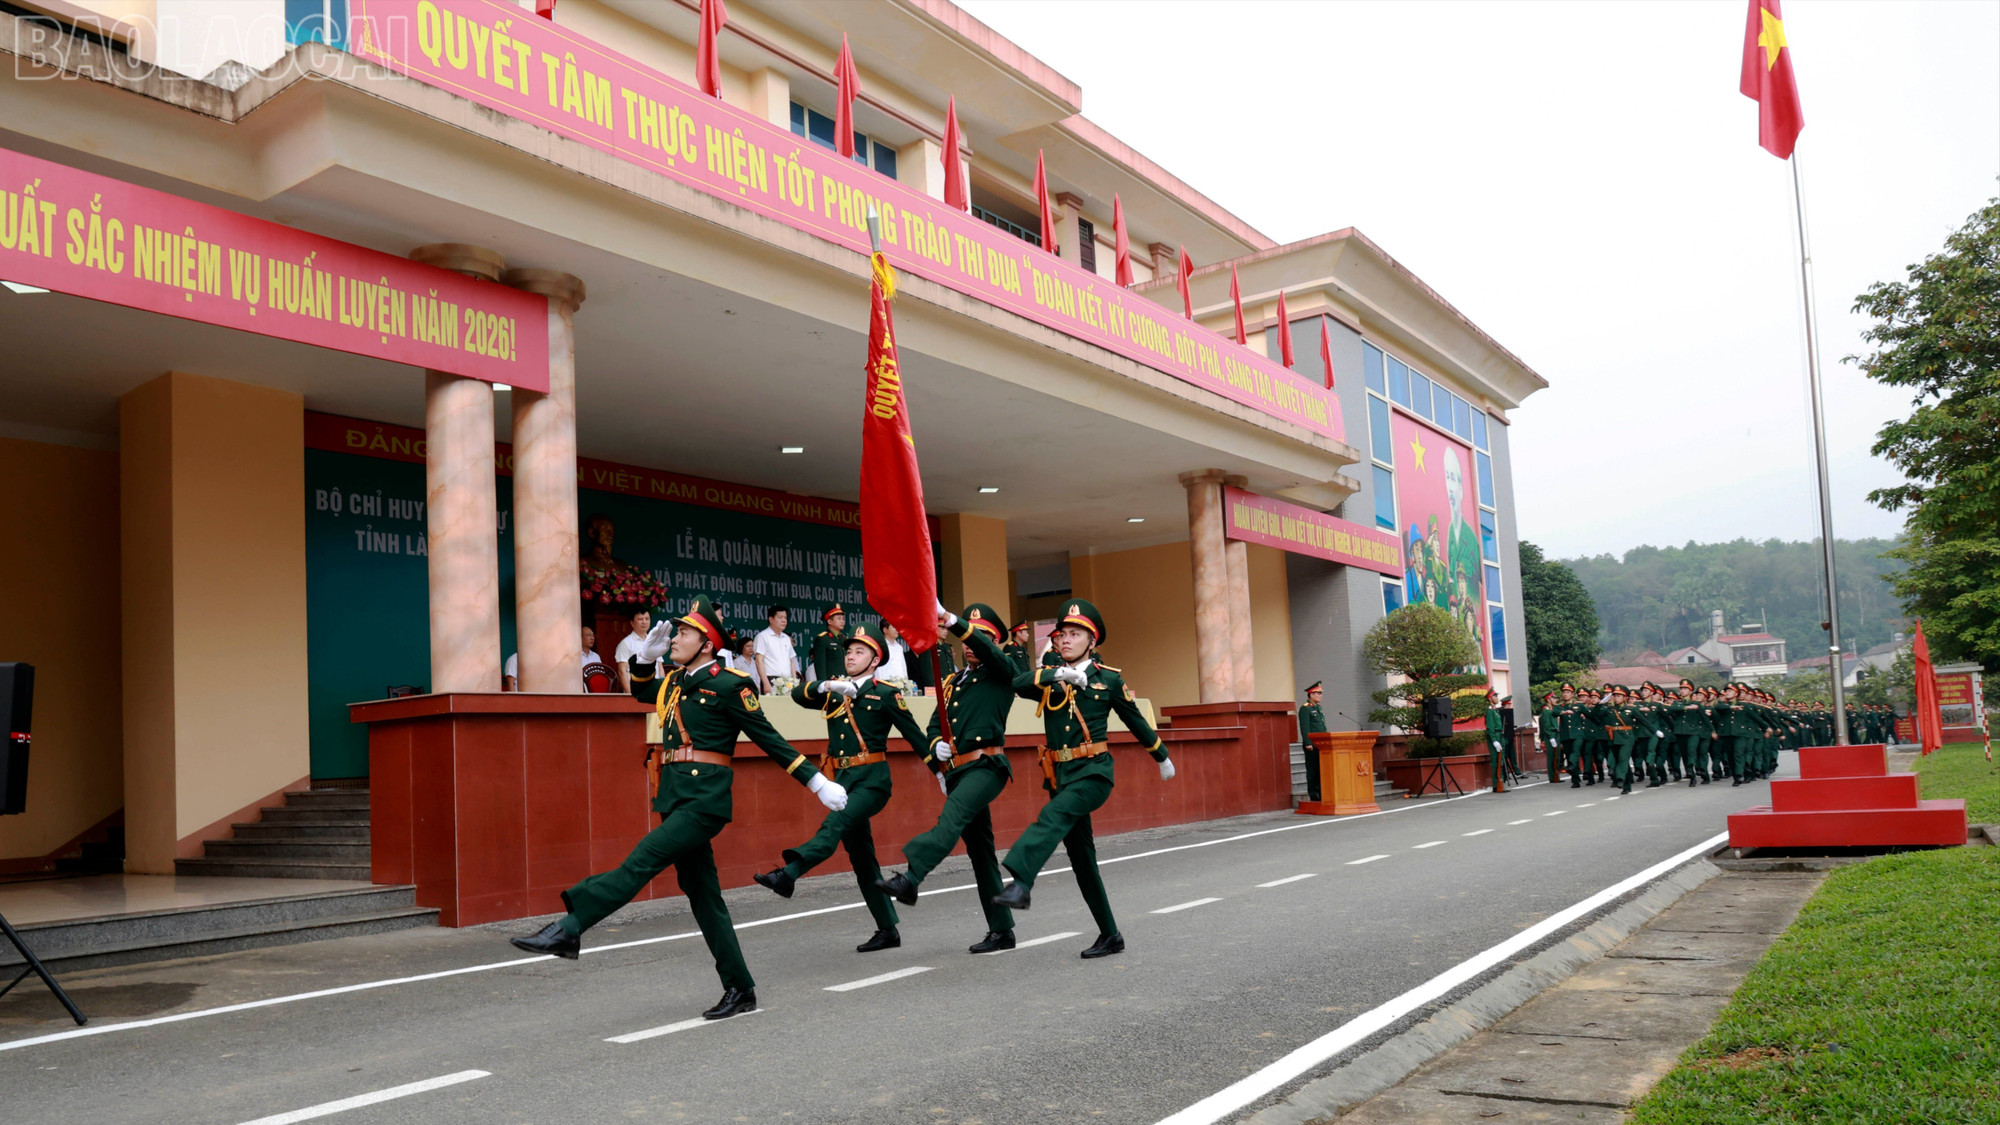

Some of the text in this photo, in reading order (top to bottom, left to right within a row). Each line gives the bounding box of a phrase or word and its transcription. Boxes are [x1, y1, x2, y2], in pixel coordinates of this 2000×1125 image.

[417, 0, 531, 96] QUYẾT
[541, 52, 613, 131] TÂM
[621, 86, 698, 167] THỰC
[705, 123, 769, 195] HIỆN
[773, 148, 815, 213] TỐT
[901, 208, 952, 268] TRÀO
[955, 231, 985, 282] THI
[987, 246, 1022, 297] ĐUA
[0, 177, 516, 362] UẤT SẮC NHIỆM VỤ HUẤN LUYỆN NĂM 2026!
[872, 355, 901, 420] QUYẾT
[345, 426, 427, 458] ĐẢNG
[592, 469, 644, 492] VIỆT
[651, 479, 698, 500] NAM
[705, 487, 775, 512] QUANG
[781, 500, 822, 519] VINH
[827, 504, 862, 526] MUÔ
[315, 486, 343, 517] BỘ
[350, 489, 382, 517] CHỈ
[388, 497, 425, 522] HUY
[355, 524, 429, 557] TỈNH LÀ
[676, 527, 864, 580] LỄ RA QUÂN HUẤN LUYỆN NĂ
[655, 569, 672, 588] VÀ
[675, 570, 707, 591] PHÁT
[710, 574, 744, 596] ĐỘNG
[746, 577, 768, 599] ĐỢT
[770, 580, 789, 598] THI
[791, 584, 812, 601] ĐUA
[814, 586, 835, 603] CAO
[837, 583, 863, 605] ĐIỂM
[733, 600, 754, 623] HỘI
[789, 607, 807, 624] XVI
[809, 607, 824, 625] VÀ
